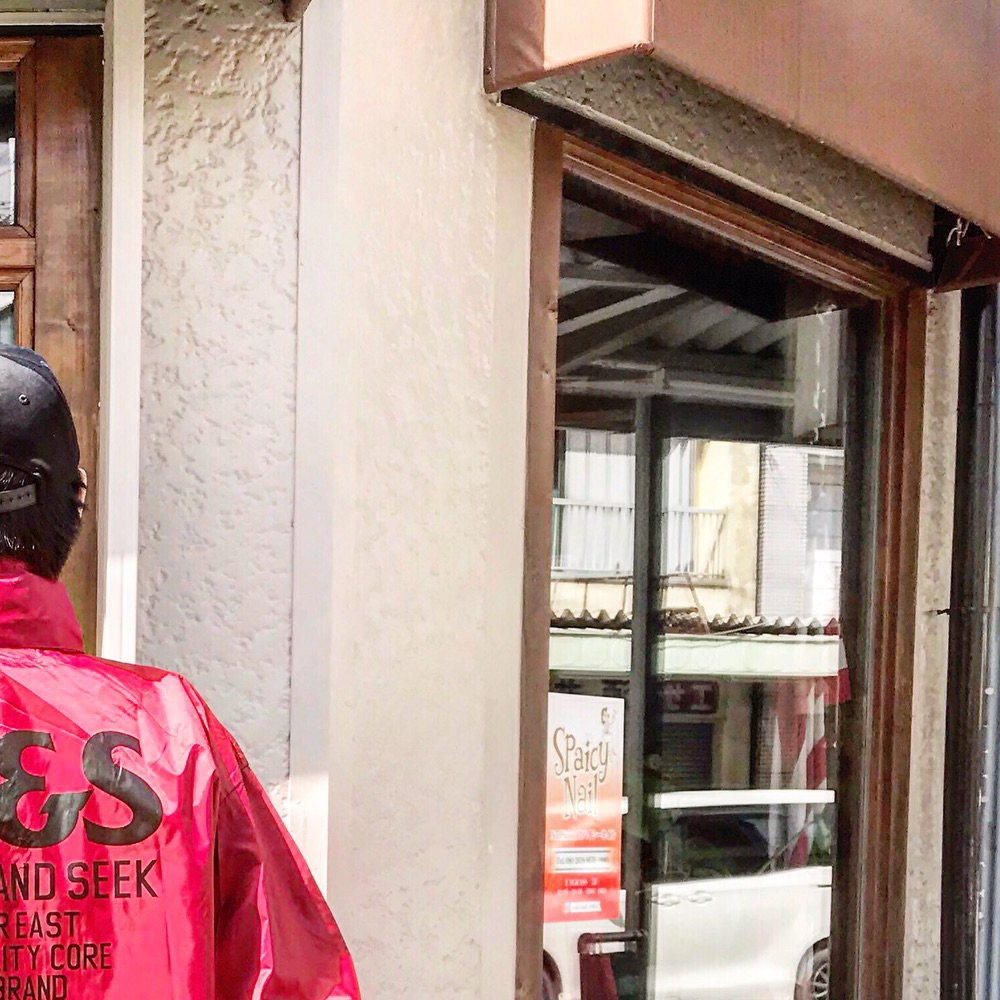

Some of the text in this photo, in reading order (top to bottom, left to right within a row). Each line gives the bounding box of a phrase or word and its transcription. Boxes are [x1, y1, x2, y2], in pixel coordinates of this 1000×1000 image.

[563, 773, 598, 819] Nail
[67, 859, 159, 900] SEEK
[15, 910, 81, 938] EAST
[50, 942, 112, 970] CORE
